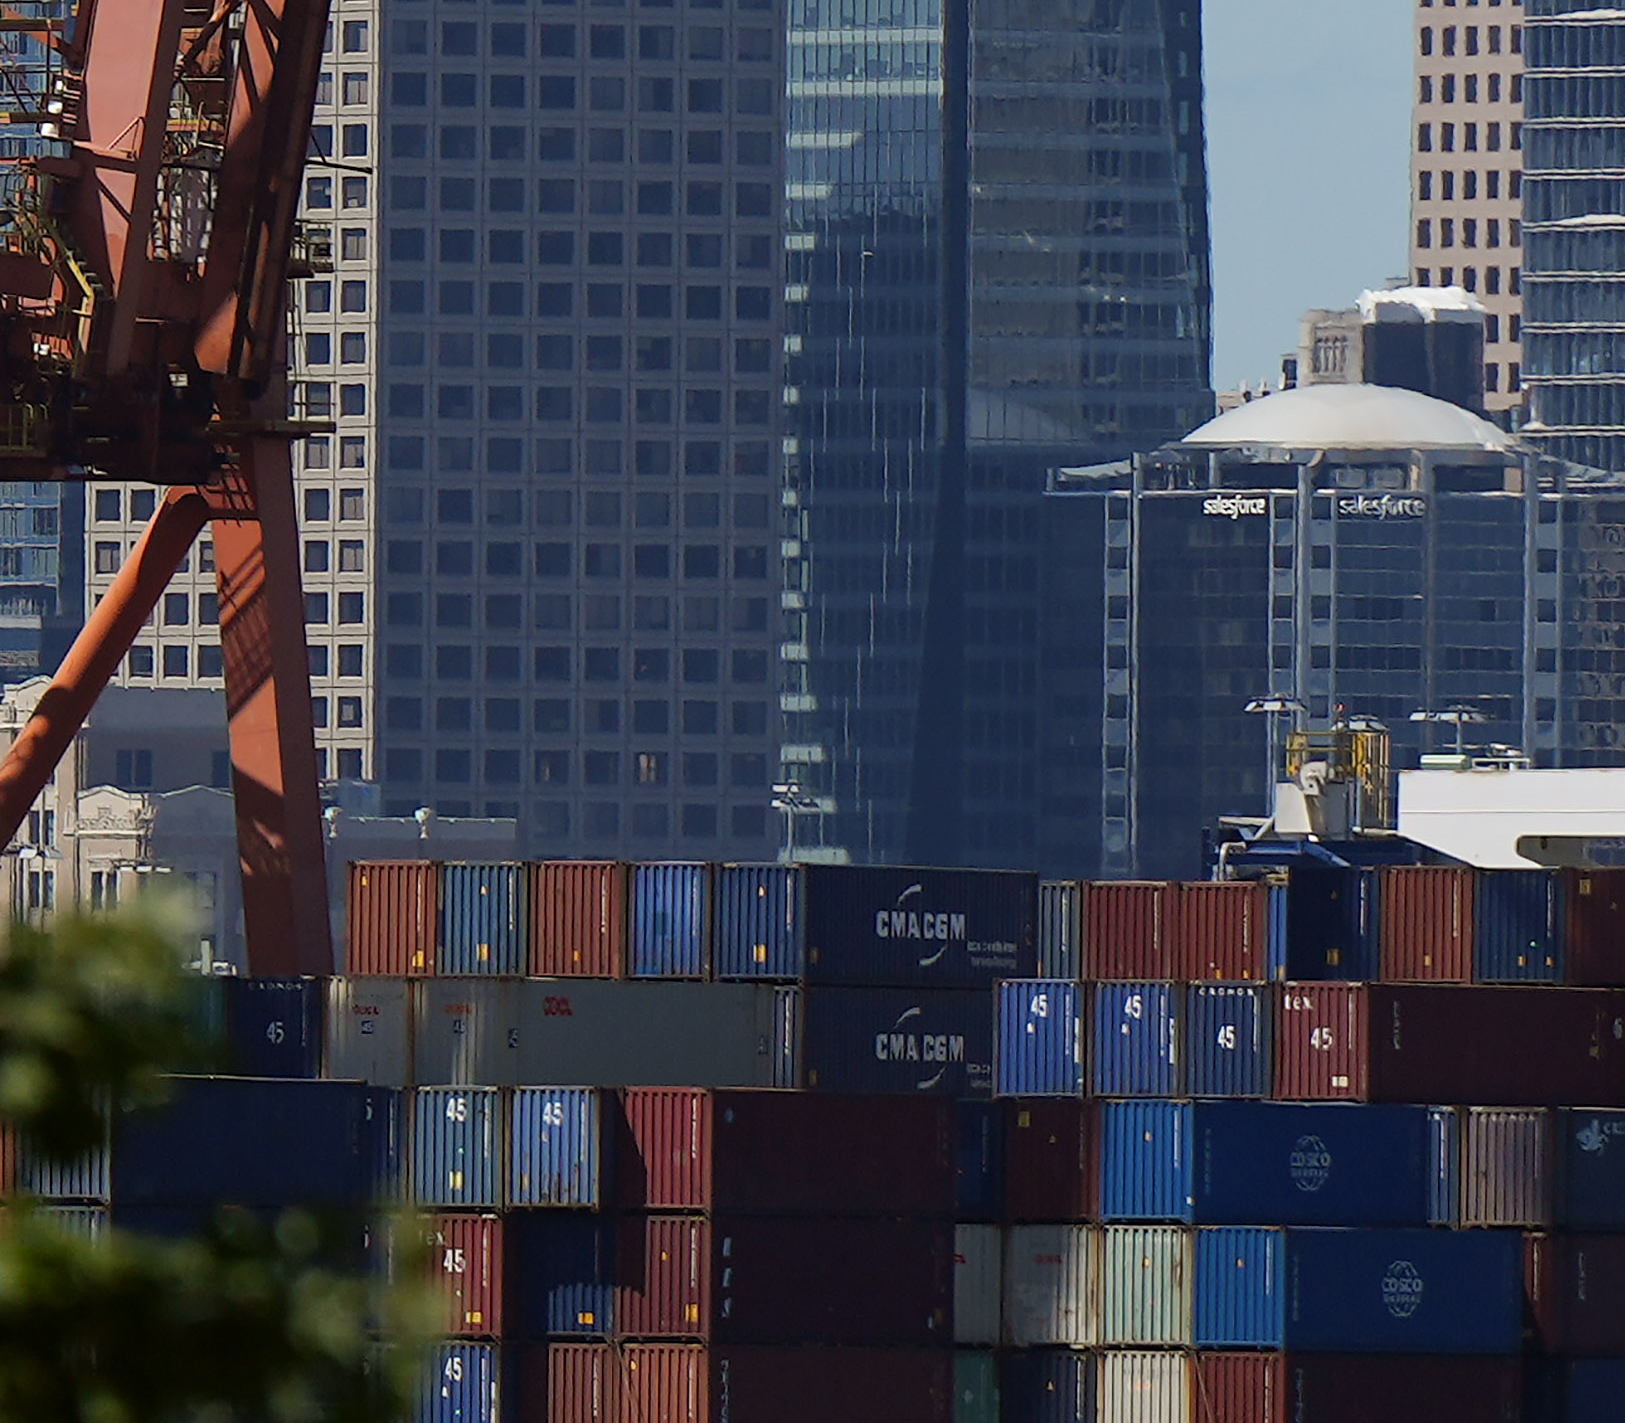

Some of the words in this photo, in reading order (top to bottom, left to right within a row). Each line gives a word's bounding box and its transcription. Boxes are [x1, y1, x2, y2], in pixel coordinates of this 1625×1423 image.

[1203, 495, 1266, 520] salesforce
[1339, 494, 1426, 520] salesforce
[875, 908, 921, 940] CMA
[923, 908, 966, 940] CGM
[1030, 994, 1048, 1019] 45
[1123, 995, 1143, 1019] 45
[1284, 993, 1314, 1011] tex
[265, 1021, 285, 1044] 45
[1217, 1025, 1237, 1050] 45
[1309, 1026, 1334, 1051] 45
[875, 1034, 918, 1062] CMA
[923, 1034, 965, 1062] CGM
[446, 1097, 467, 1123] 45
[542, 1101, 564, 1127] 45
[443, 1248, 466, 1273] 45
[444, 1357, 463, 1382] 45
